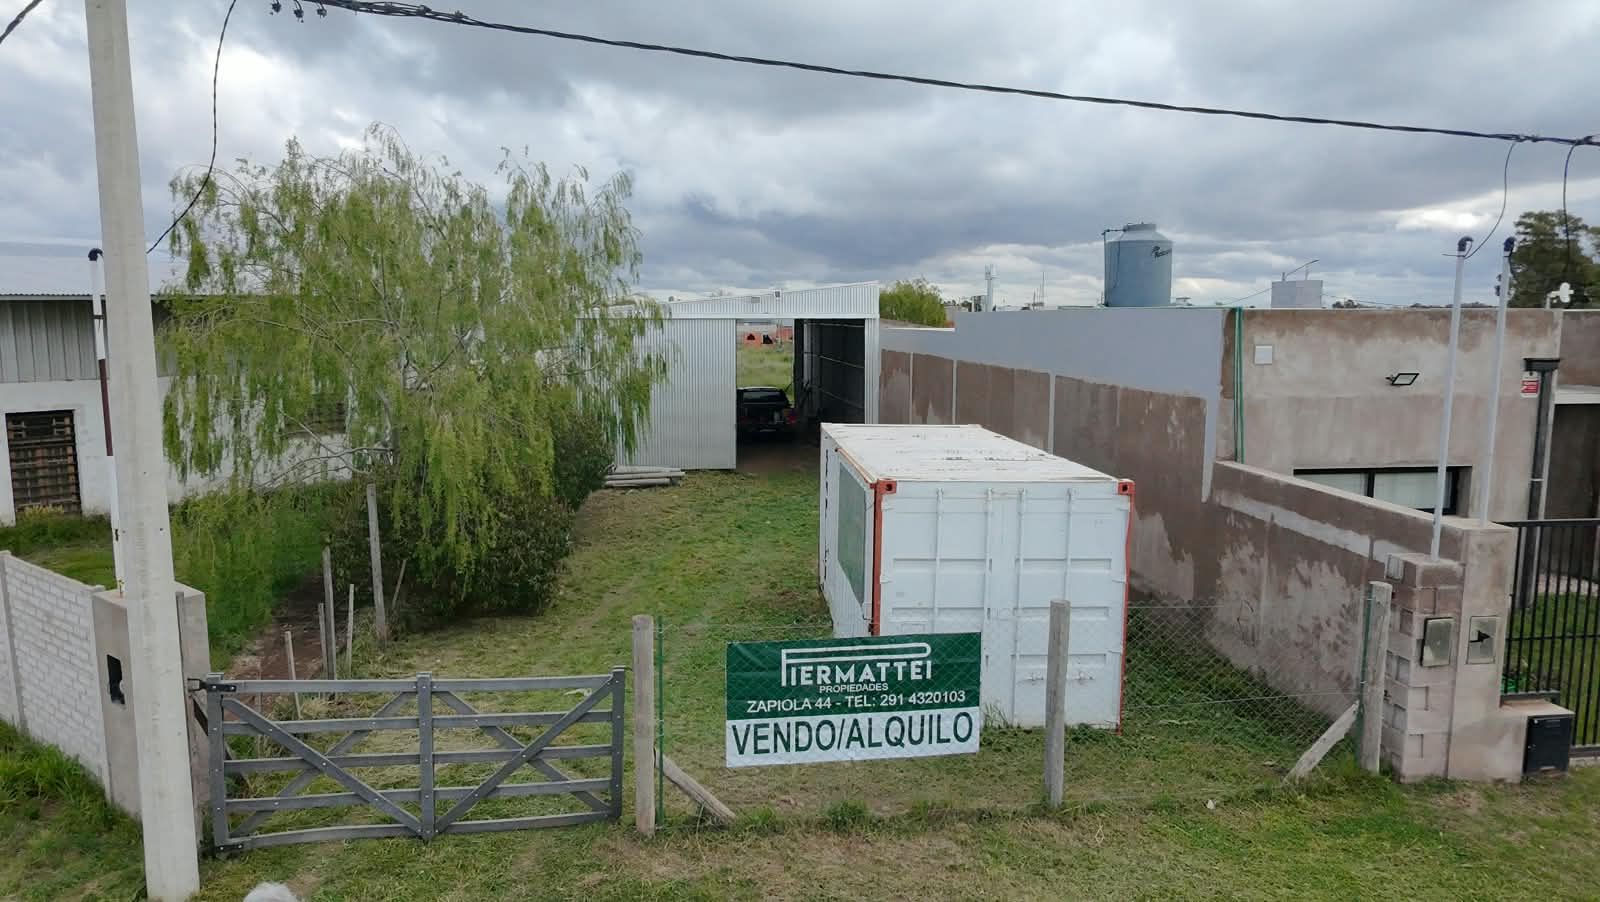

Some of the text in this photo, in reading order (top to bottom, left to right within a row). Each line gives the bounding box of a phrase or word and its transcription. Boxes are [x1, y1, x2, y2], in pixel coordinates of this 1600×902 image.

[781, 642, 932, 687] PIERMATTEI
[747, 699, 812, 713] ZAPIOLA
[814, 697, 831, 709] 44
[845, 695, 876, 708] TEL:
[880, 694, 903, 707] 291
[908, 690, 966, 704] 4320103
[819, 682, 889, 694] PROPIEDADES
[732, 711, 973, 755] VENDO/ALQUILO
